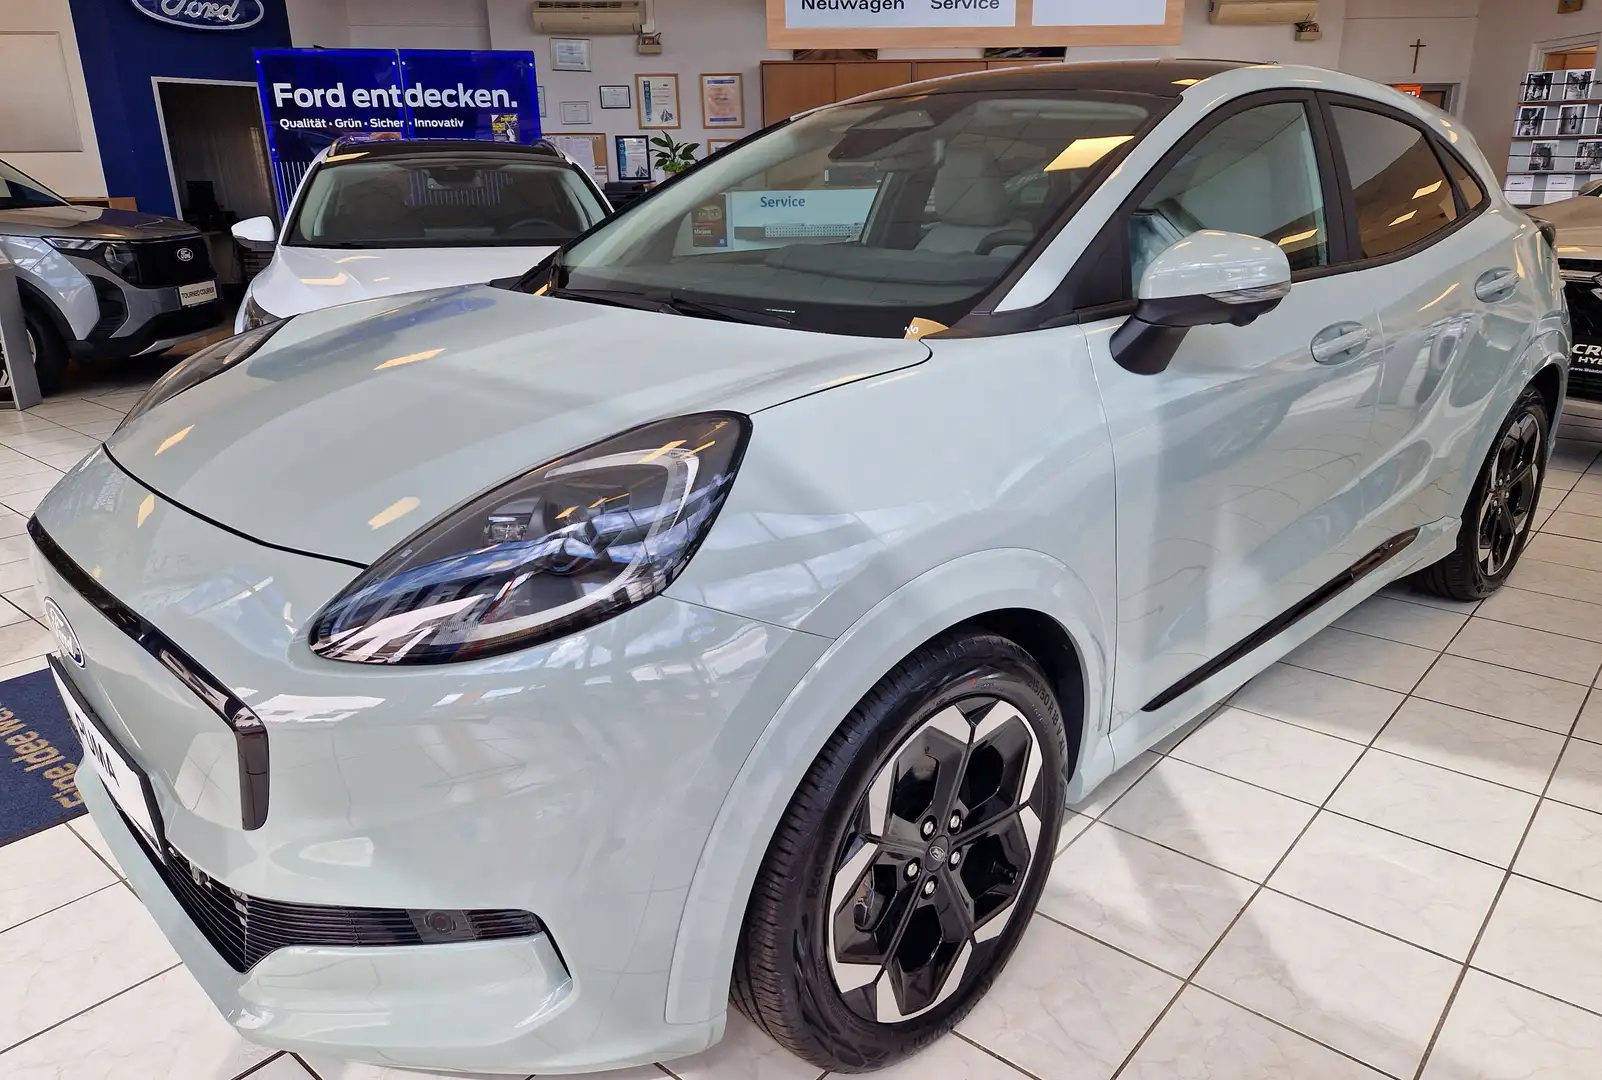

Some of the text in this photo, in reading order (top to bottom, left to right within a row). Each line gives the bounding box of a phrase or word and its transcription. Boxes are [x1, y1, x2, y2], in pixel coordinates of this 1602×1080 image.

[801, 0, 1000, 13] Neuwagen Service
[272, 82, 518, 108] Ford entdecken.
[279, 117, 464, 129] Qualität Grün Sicher Innovativ
[760, 195, 806, 208] Service
[1572, 343, 1602, 356] CR
[4, 730, 67, 773] Idee
[74, 710, 120, 788] PUMA
